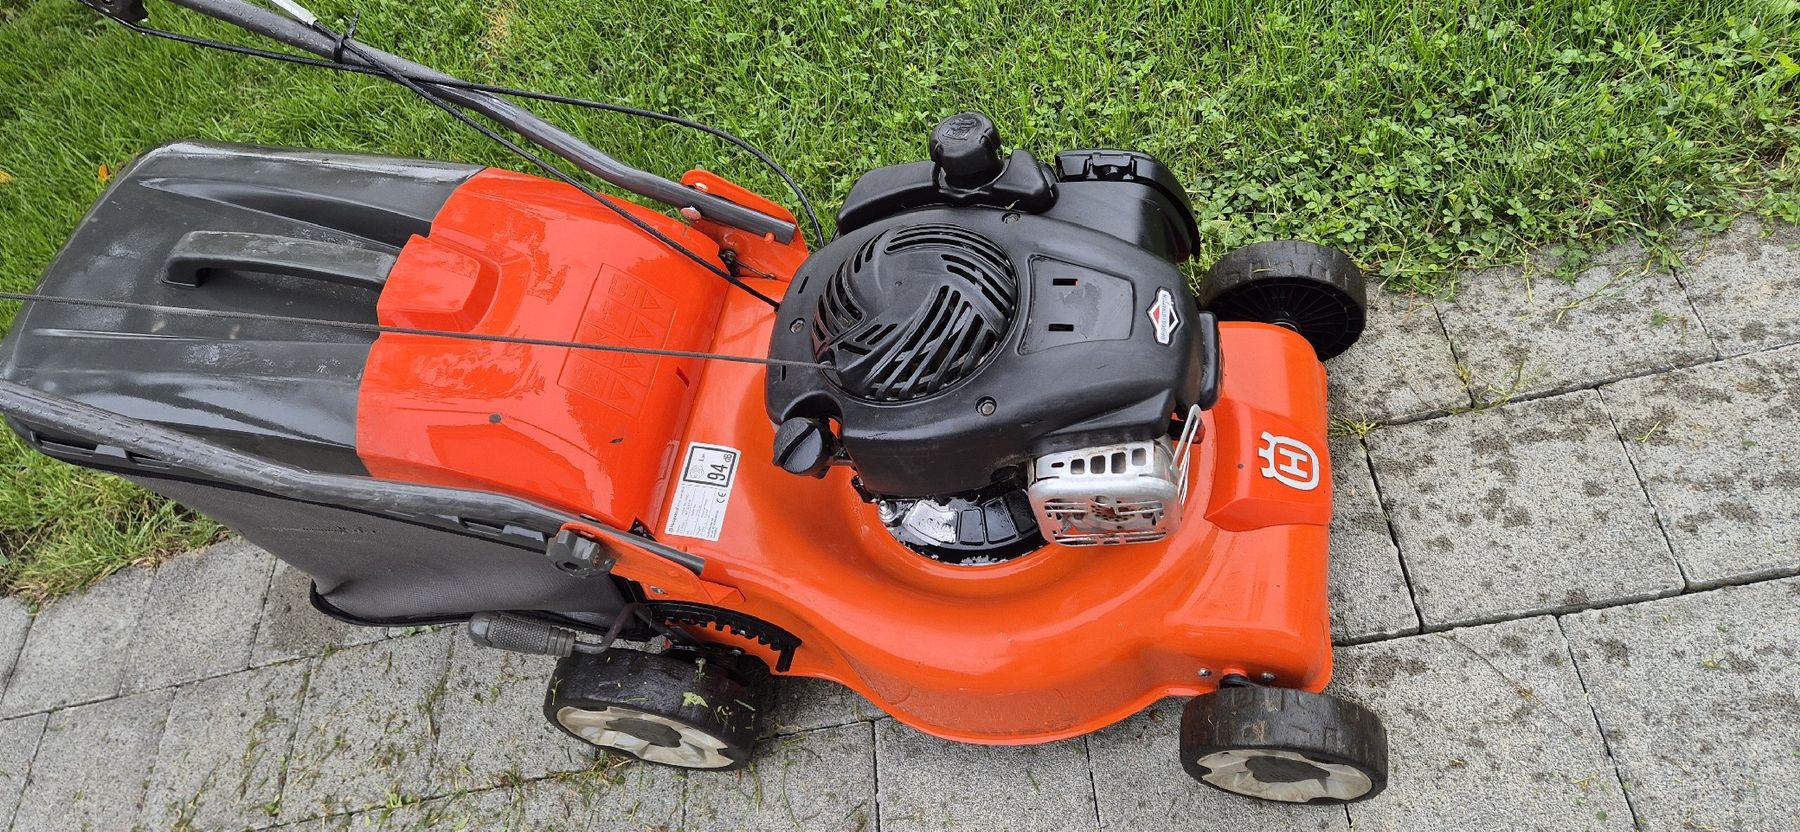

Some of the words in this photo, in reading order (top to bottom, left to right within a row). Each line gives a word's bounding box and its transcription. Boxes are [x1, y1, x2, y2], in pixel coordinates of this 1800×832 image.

[707, 464, 728, 481] 94
[723, 453, 732, 463] dB
[716, 491, 727, 504] CE
